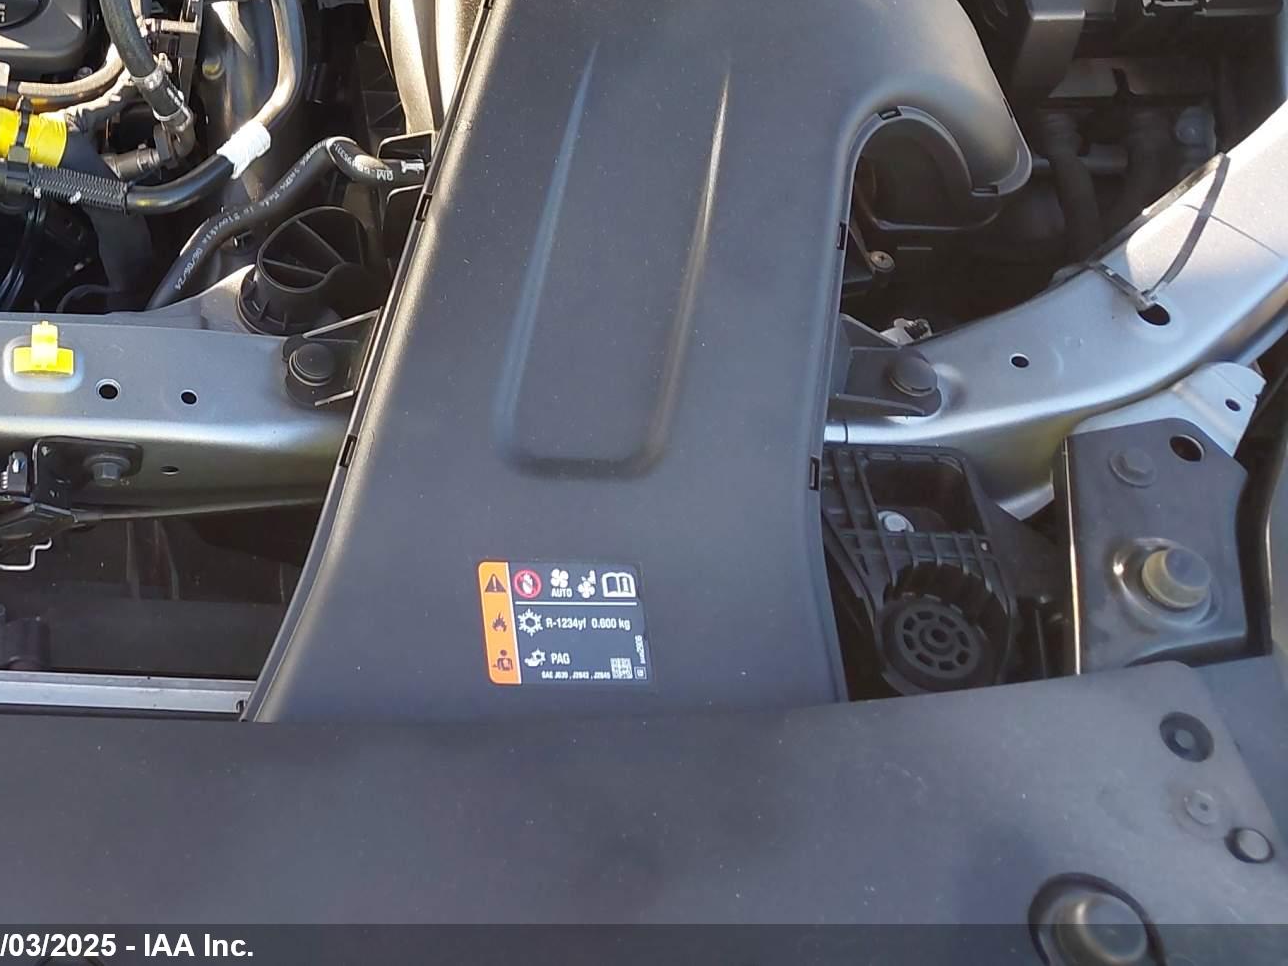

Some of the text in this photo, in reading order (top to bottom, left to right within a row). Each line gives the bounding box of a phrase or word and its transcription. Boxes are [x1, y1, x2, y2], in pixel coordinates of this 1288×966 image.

[551, 588, 572, 598] AUTO
[546, 617, 587, 631] R-1234yf
[618, 618, 631, 631] kg
[550, 653, 571, 665] PAG
